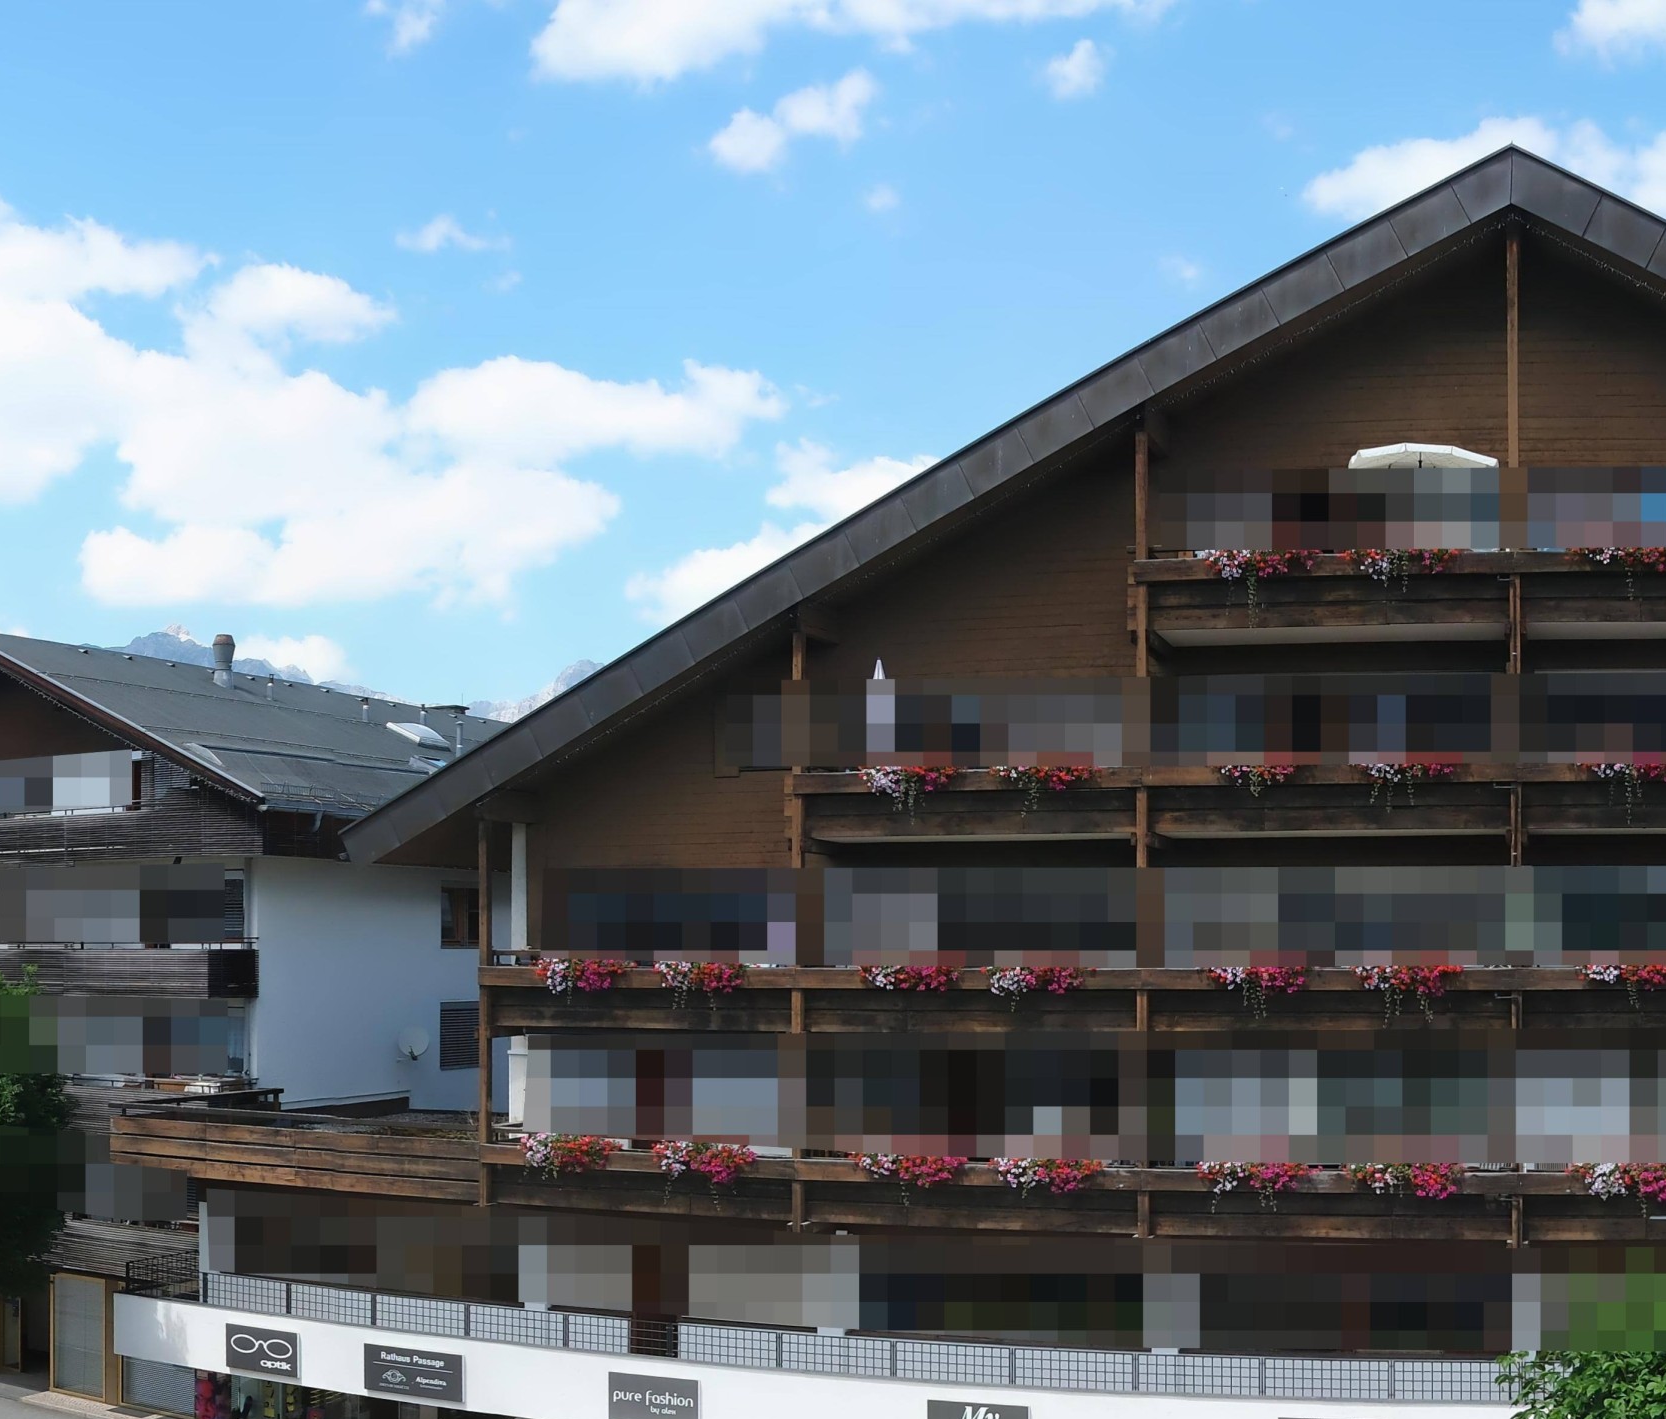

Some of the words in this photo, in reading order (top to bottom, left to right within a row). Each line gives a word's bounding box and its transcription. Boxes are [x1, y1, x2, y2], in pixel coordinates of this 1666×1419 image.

[260, 1359, 292, 1371] optik
[380, 1351, 411, 1364] Rathaus
[412, 1355, 445, 1369] Passage
[613, 1390, 643, 1403] pure
[645, 1390, 694, 1408] fashion
[650, 1405, 660, 1415] by
